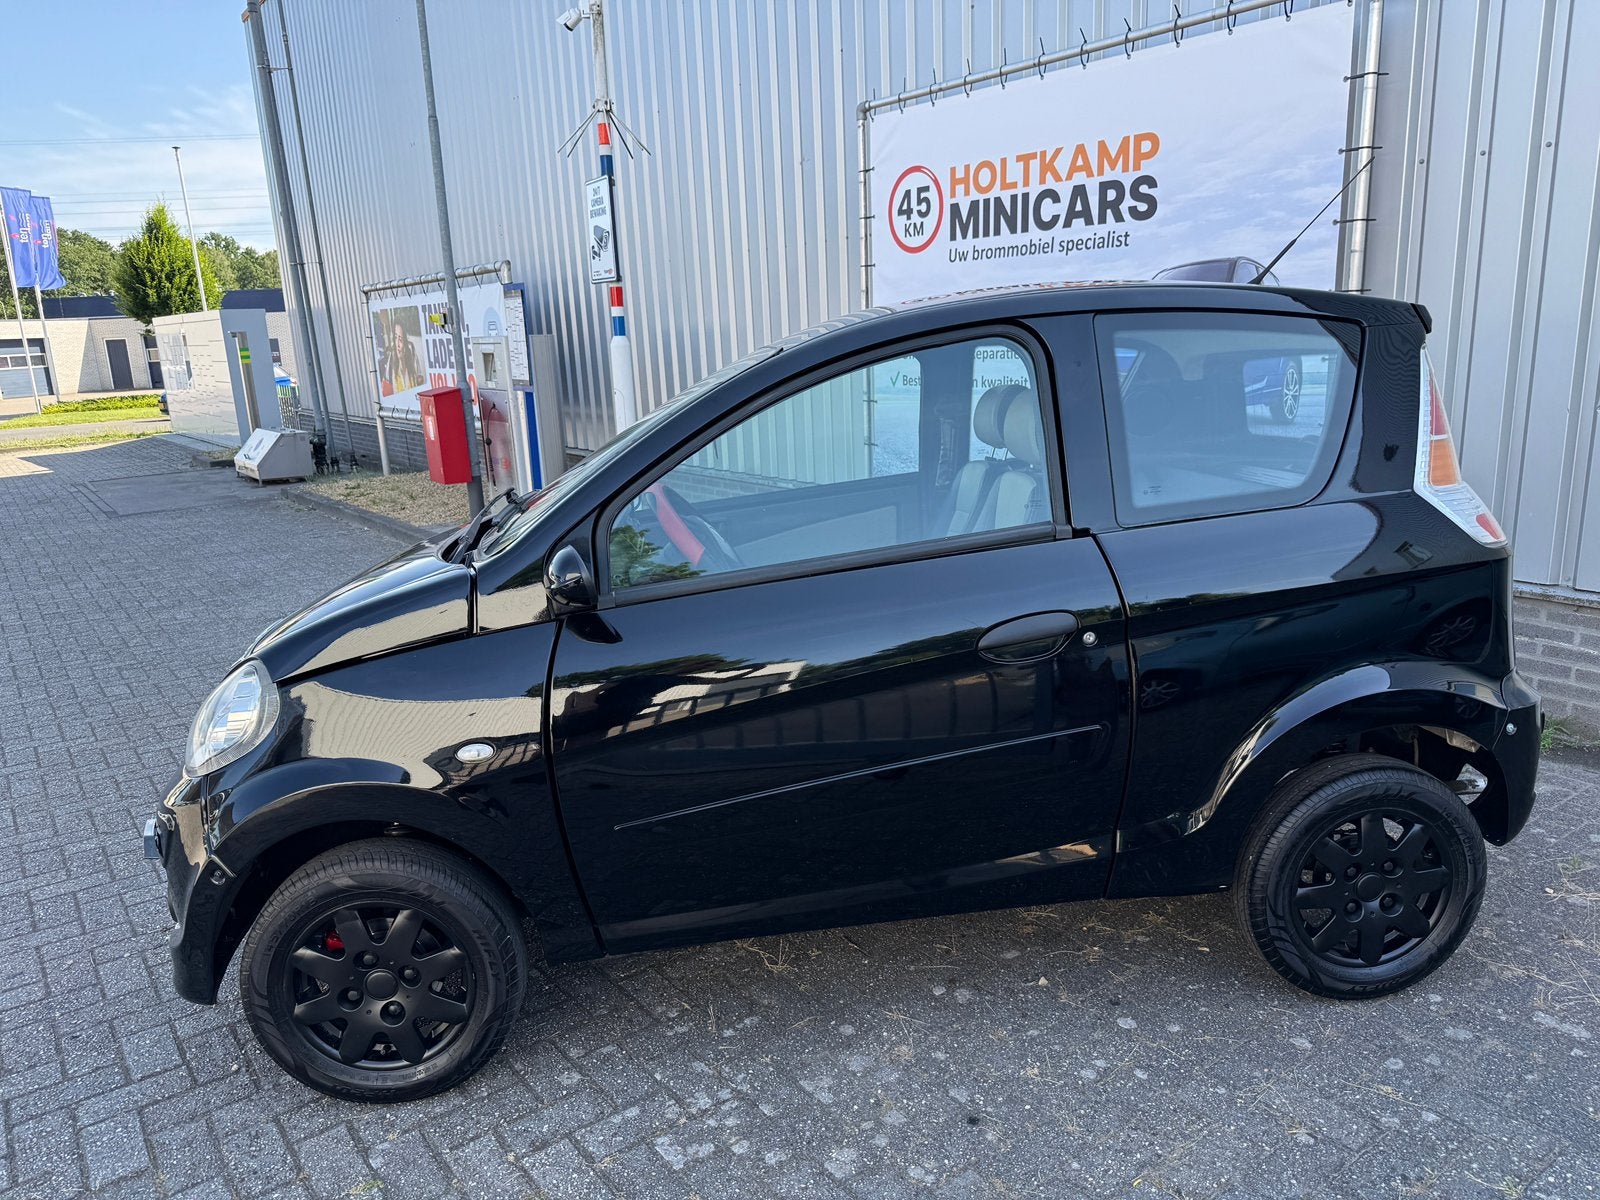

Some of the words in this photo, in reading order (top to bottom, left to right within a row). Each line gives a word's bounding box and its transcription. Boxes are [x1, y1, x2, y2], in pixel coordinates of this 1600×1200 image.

[949, 132, 1160, 199] HOLTKAMP
[897, 185, 931, 221] 45
[949, 174, 1158, 242] MINICARS
[904, 221, 924, 238] KM
[949, 248, 969, 263] Uw
[972, 237, 1055, 261] brommobiel
[1058, 231, 1130, 256] specialist
[975, 348, 1020, 362] eparati
